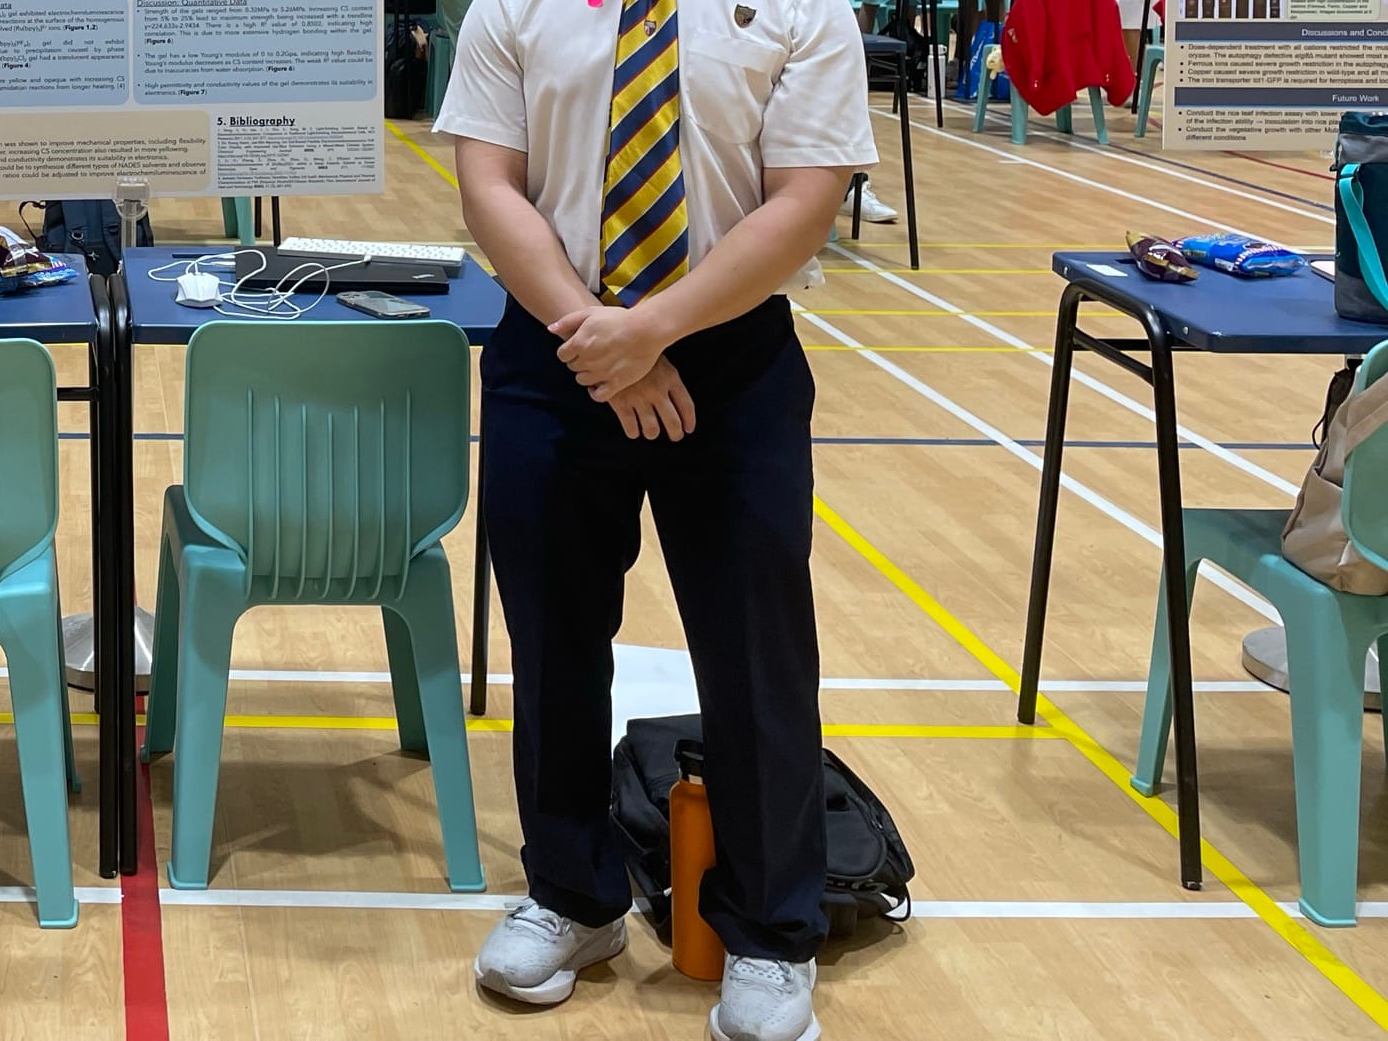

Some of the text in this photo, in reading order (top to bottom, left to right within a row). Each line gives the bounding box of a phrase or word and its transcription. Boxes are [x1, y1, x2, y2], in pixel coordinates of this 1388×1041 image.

[136, 0, 180, 7] Discussion:
[1300, 28, 1348, 36] Discussions
[1349, 28, 1364, 36] and
[216, 116, 295, 127] 5. Bibliography
